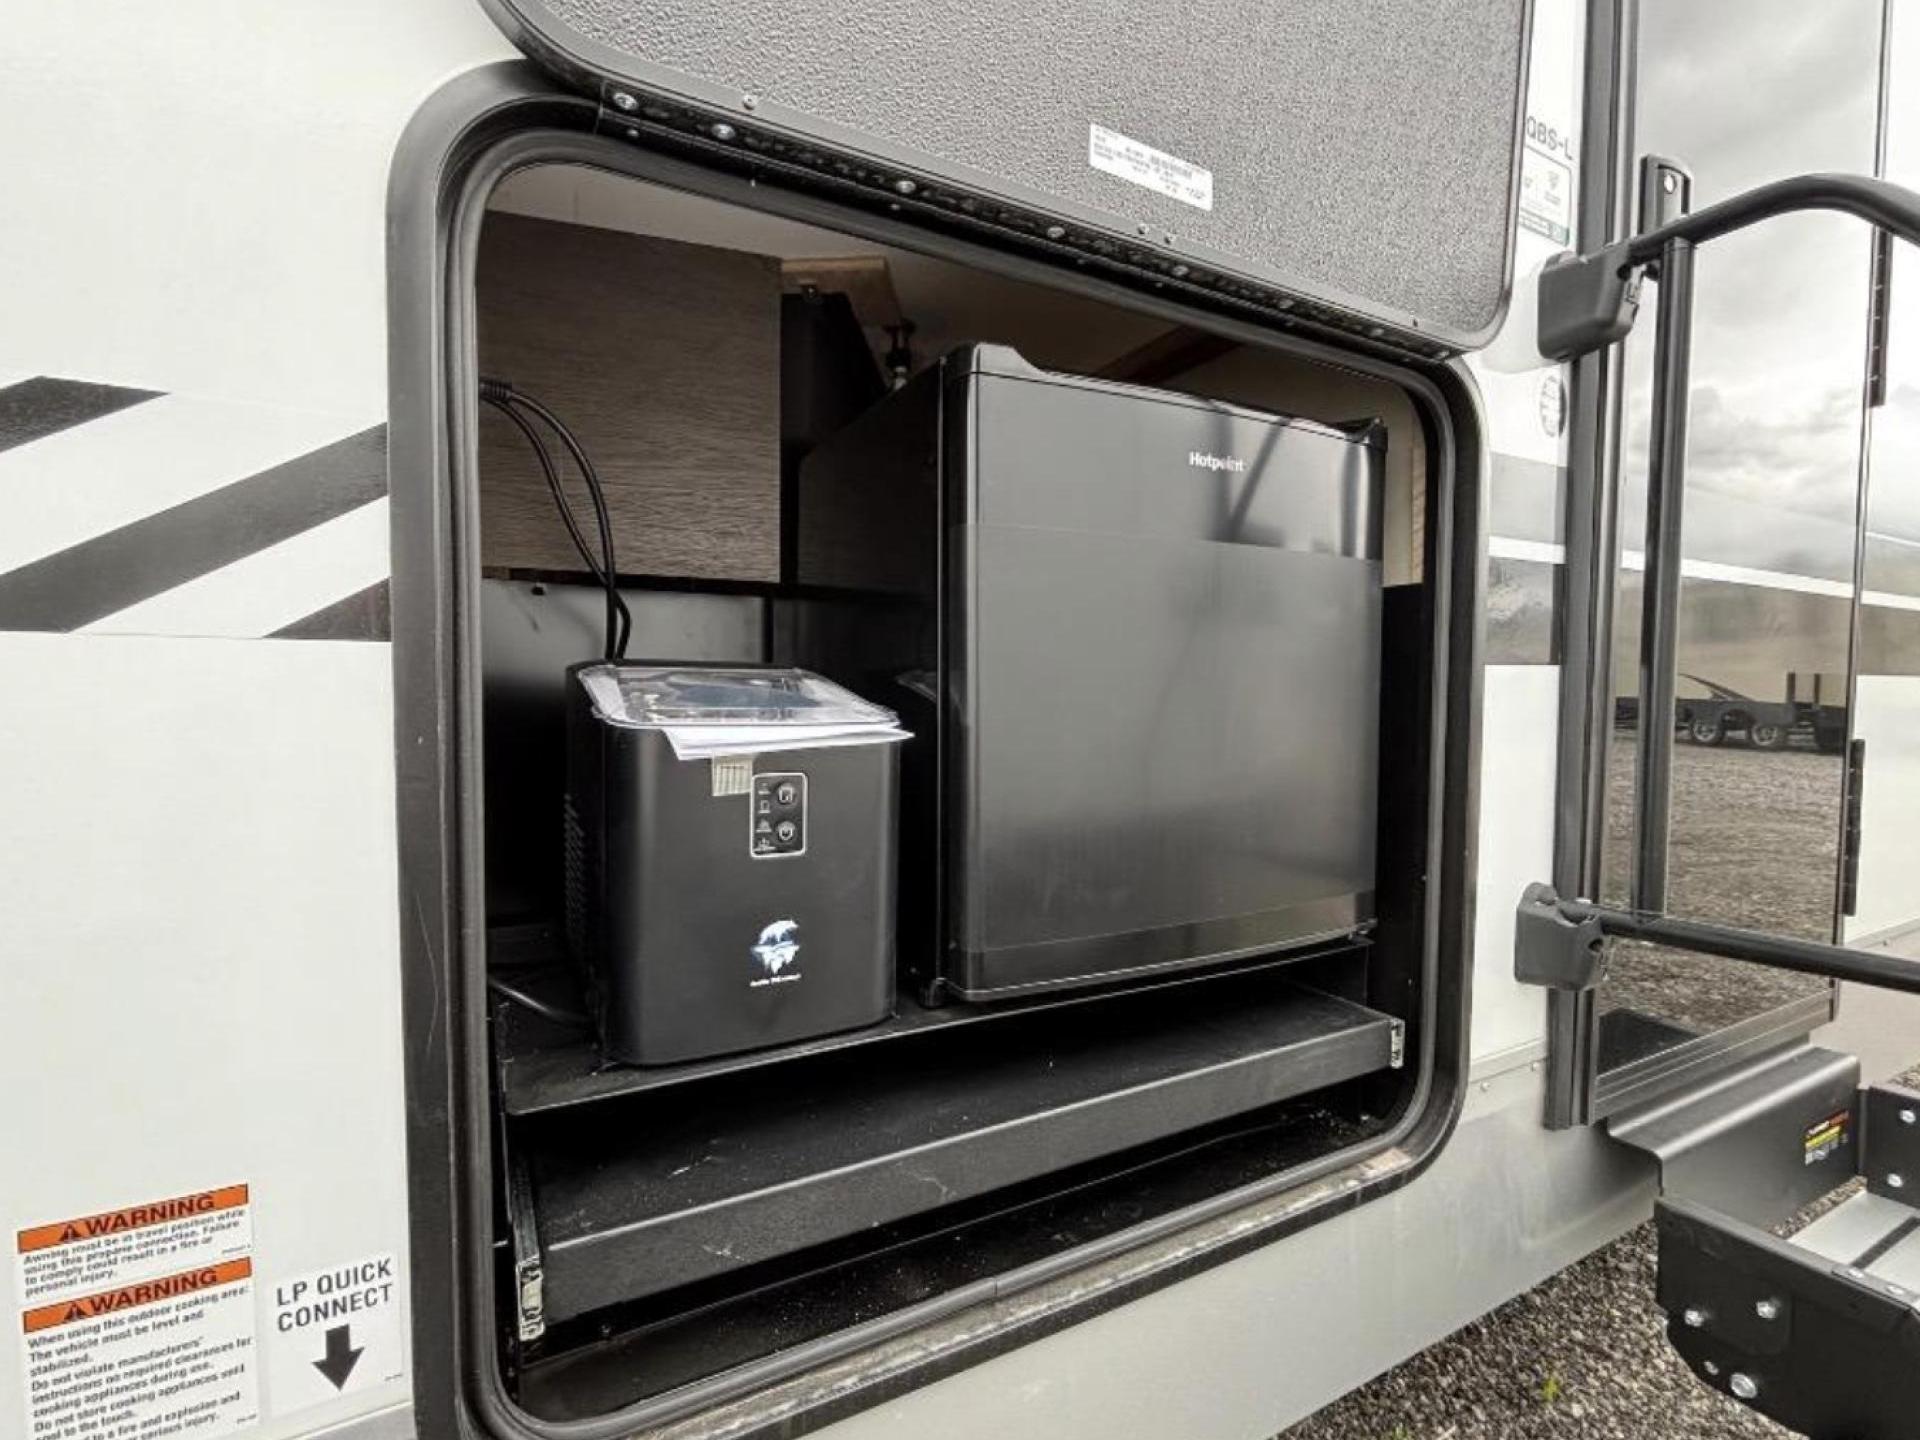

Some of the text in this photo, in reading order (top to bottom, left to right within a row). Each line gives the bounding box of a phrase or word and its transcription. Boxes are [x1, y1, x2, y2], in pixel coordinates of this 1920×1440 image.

[1189, 451, 1244, 472] Hotpoint
[86, 1195, 214, 1235] WARNING
[24, 1248, 69, 1265] Awning
[72, 1239, 101, 1253] must
[104, 1237, 118, 1246] be
[135, 1224, 168, 1239] travel
[171, 1216, 215, 1233] position
[24, 1262, 57, 1276] using
[60, 1255, 82, 1267] this
[86, 1246, 132, 1263] propane
[202, 1220, 240, 1235] Failure
[25, 1276, 37, 1286] to
[40, 1267, 84, 1283] comply
[86, 1256, 118, 1272] could
[121, 1248, 154, 1264] result
[157, 1246, 168, 1255] in
[180, 1239, 198, 1250] fire
[25, 1277, 77, 1299] personal
[90, 1270, 217, 1310] WARNING
[277, 1258, 392, 1307] LP QUICK
[28, 1334, 64, 1349] When
[68, 1324, 101, 1340] using
[103, 1317, 125, 1331] this
[128, 1306, 171, 1323] outdoor
[175, 1294, 219, 1312] cooking
[278, 1283, 392, 1332] CONNECT
[29, 1310, 203, 1363] The vehicle must be level and
[32, 1378, 102, 1404] instructions
[123, 1357, 172, 1379] required
[175, 1342, 234, 1364] clearances
[236, 1337, 251, 1348] for
[32, 1380, 49, 1392] Do
[51, 1373, 71, 1386] not
[74, 1362, 115, 1379] violate
[33, 1398, 81, 1418] cooking
[84, 1380, 148, 1404] appliances
[150, 1368, 187, 1385] during
[34, 1363, 244, 1433] Do not store cooking appliances until
[140, 1414, 162, 1430] and
[165, 1400, 217, 1422] explosion
[221, 1390, 240, 1405] and
